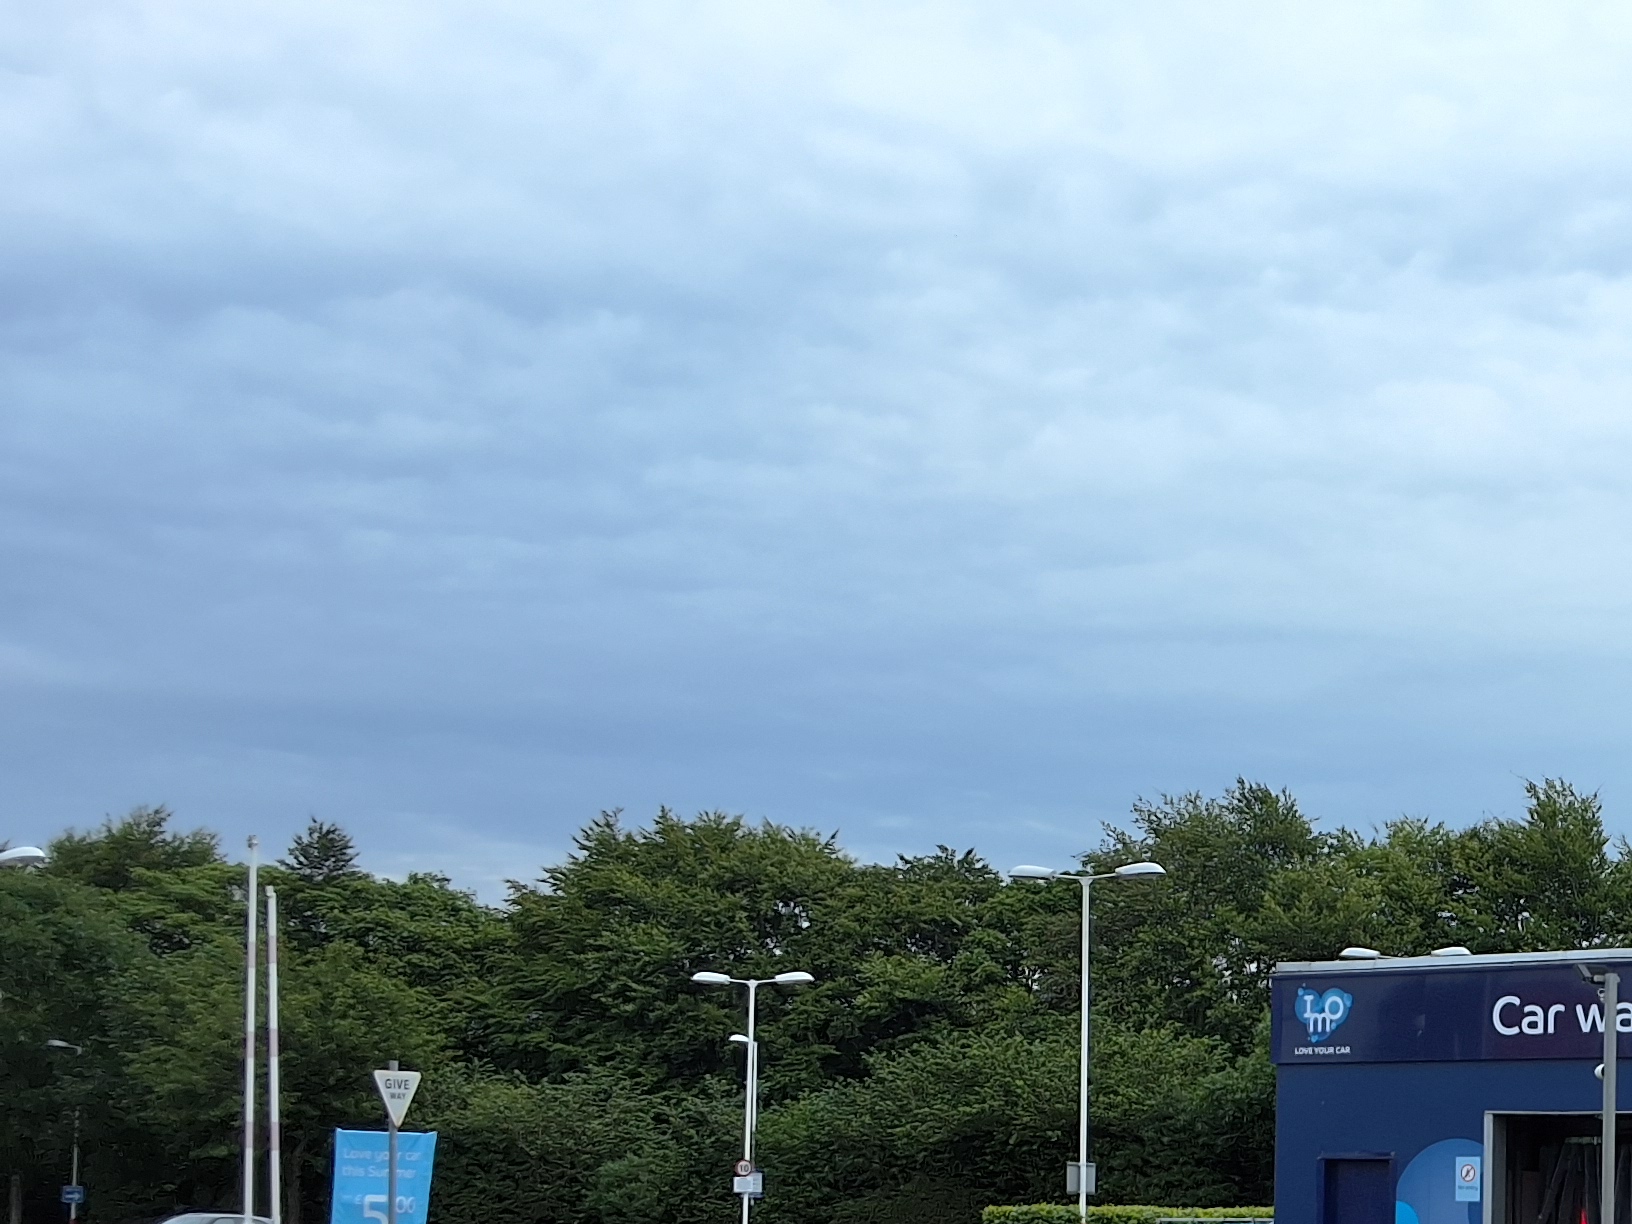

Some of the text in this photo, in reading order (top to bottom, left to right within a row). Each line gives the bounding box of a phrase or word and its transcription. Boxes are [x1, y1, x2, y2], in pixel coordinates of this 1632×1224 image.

[1492, 995, 1566, 1036] Car
[1314, 1046, 1334, 1055] YOUR
[1335, 1045, 1351, 1054] CAR
[384, 1078, 410, 1090] GIVE
[389, 1092, 406, 1100] WAY
[343, 1148, 371, 1160] Love
[374, 1151, 402, 1163] yor
[368, 1166, 416, 1178] Sumer
[740, 1164, 749, 1173] 10
